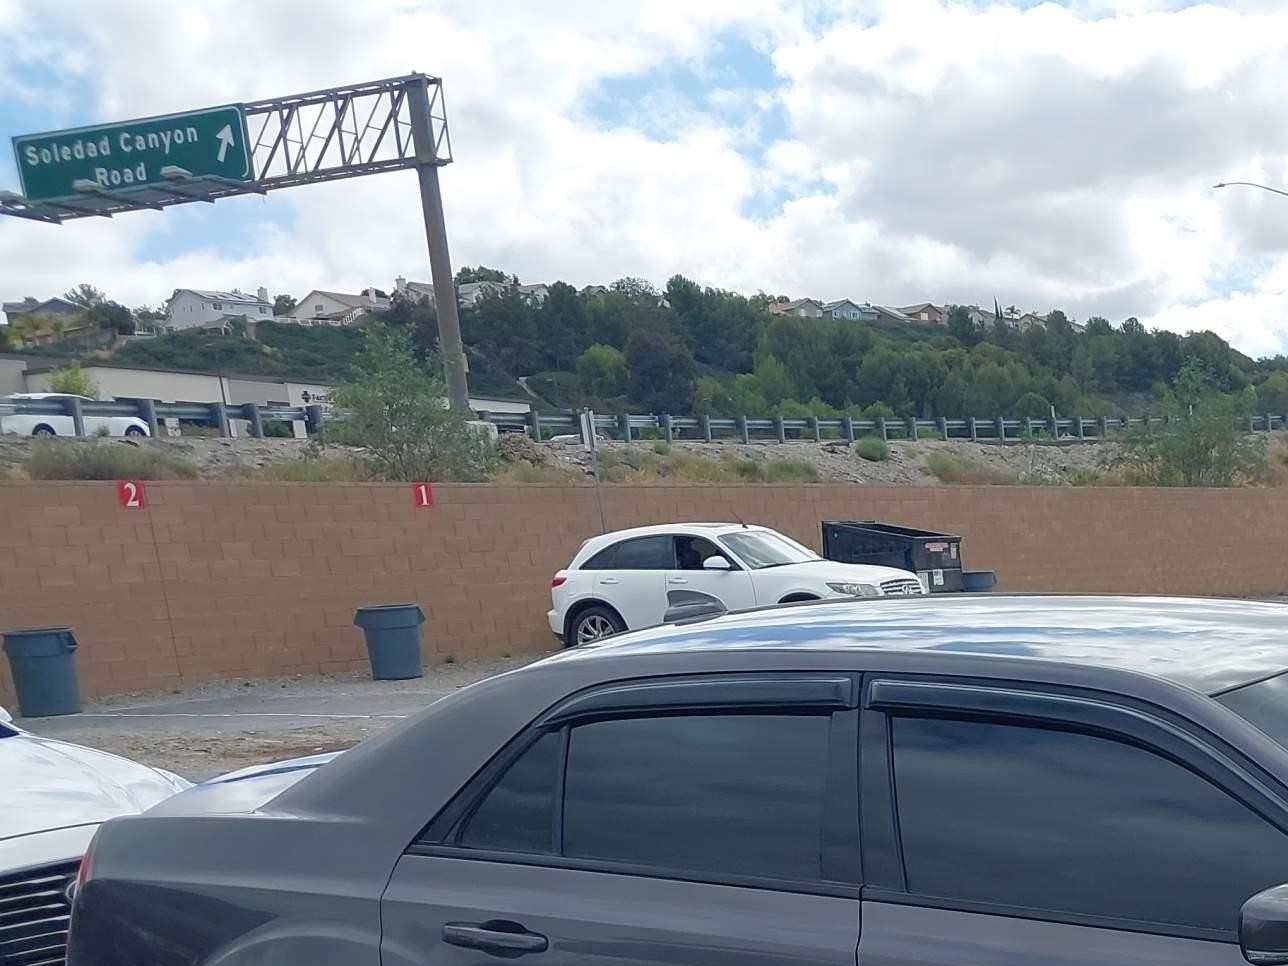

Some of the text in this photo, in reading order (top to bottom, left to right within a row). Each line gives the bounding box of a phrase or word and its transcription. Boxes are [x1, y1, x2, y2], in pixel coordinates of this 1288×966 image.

[25, 126, 199, 167] Soledad Canyon
[95, 162, 147, 186] Road
[123, 482, 140, 507] 2
[416, 484, 430, 507] 1
